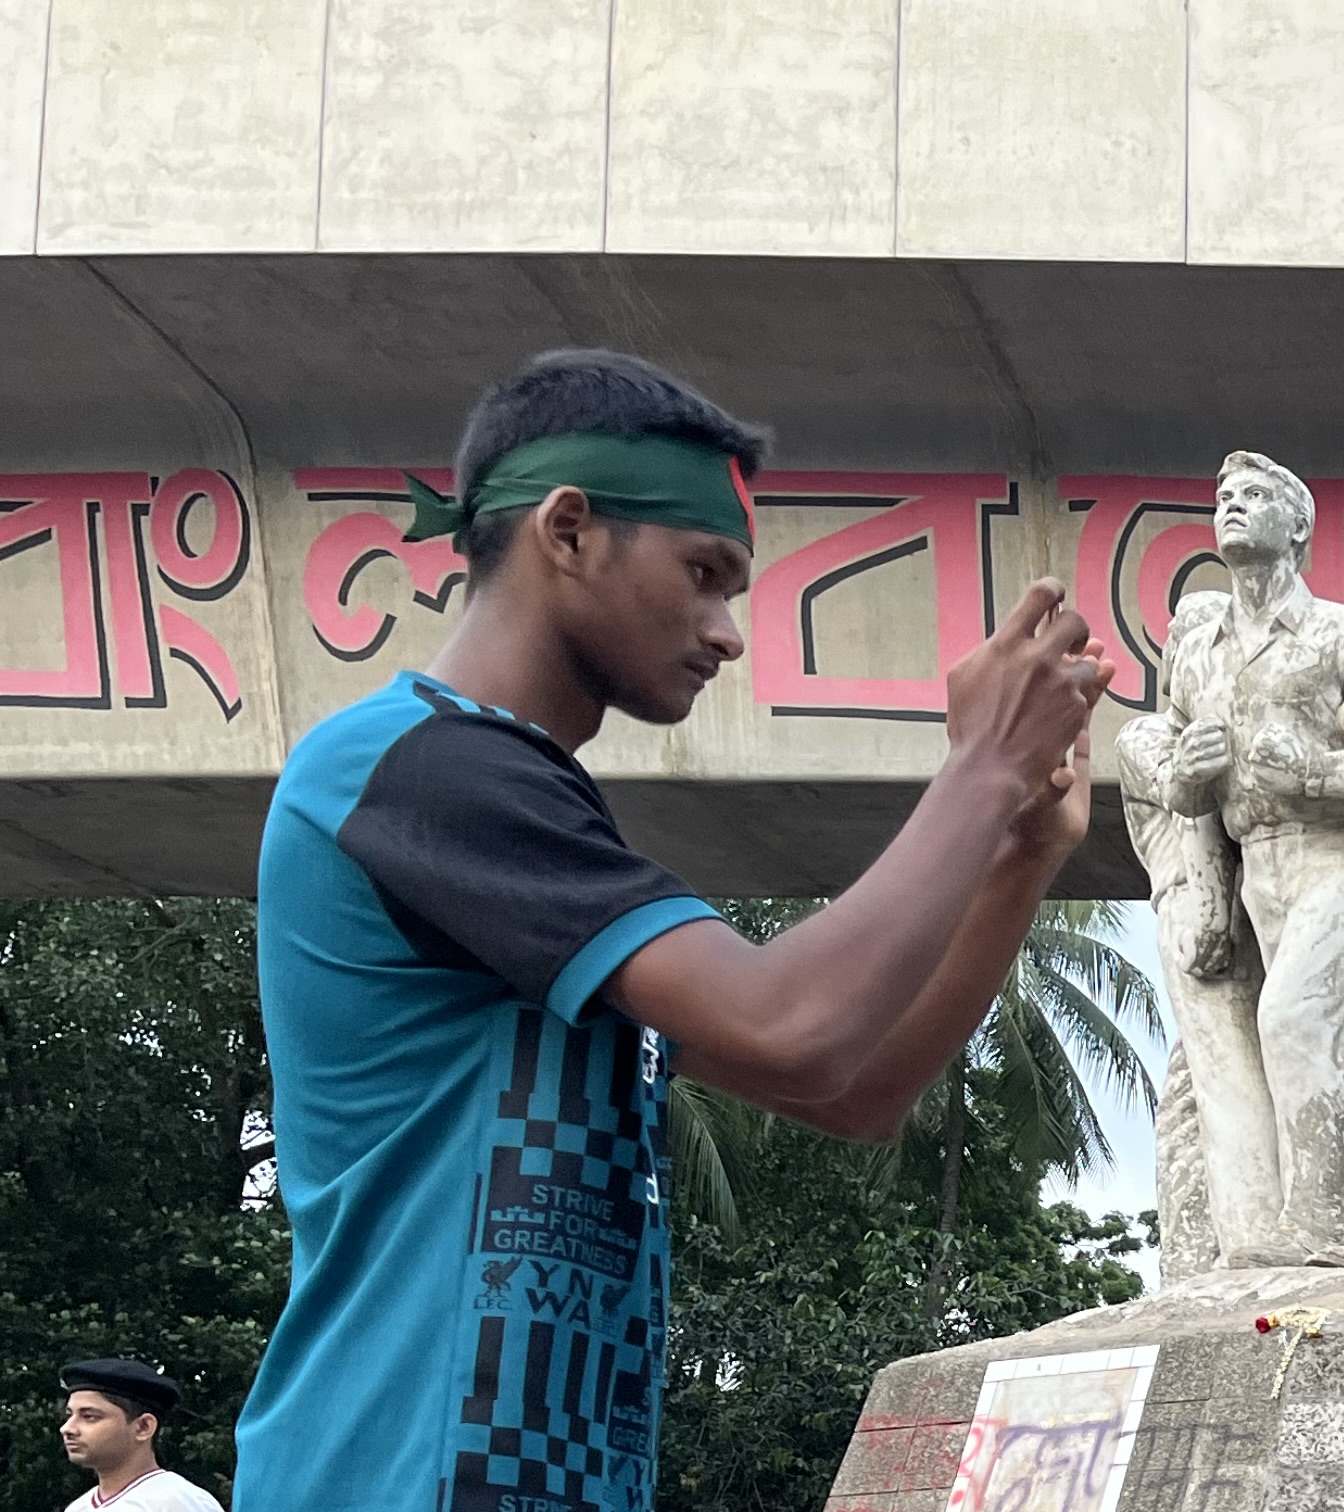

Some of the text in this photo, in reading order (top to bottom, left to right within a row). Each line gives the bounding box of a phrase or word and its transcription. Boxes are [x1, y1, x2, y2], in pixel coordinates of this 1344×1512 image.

[531, 1184, 614, 1222] STRIVE
[549, 1211, 601, 1238] FOR
[494, 1229, 628, 1276] GREATNESS
